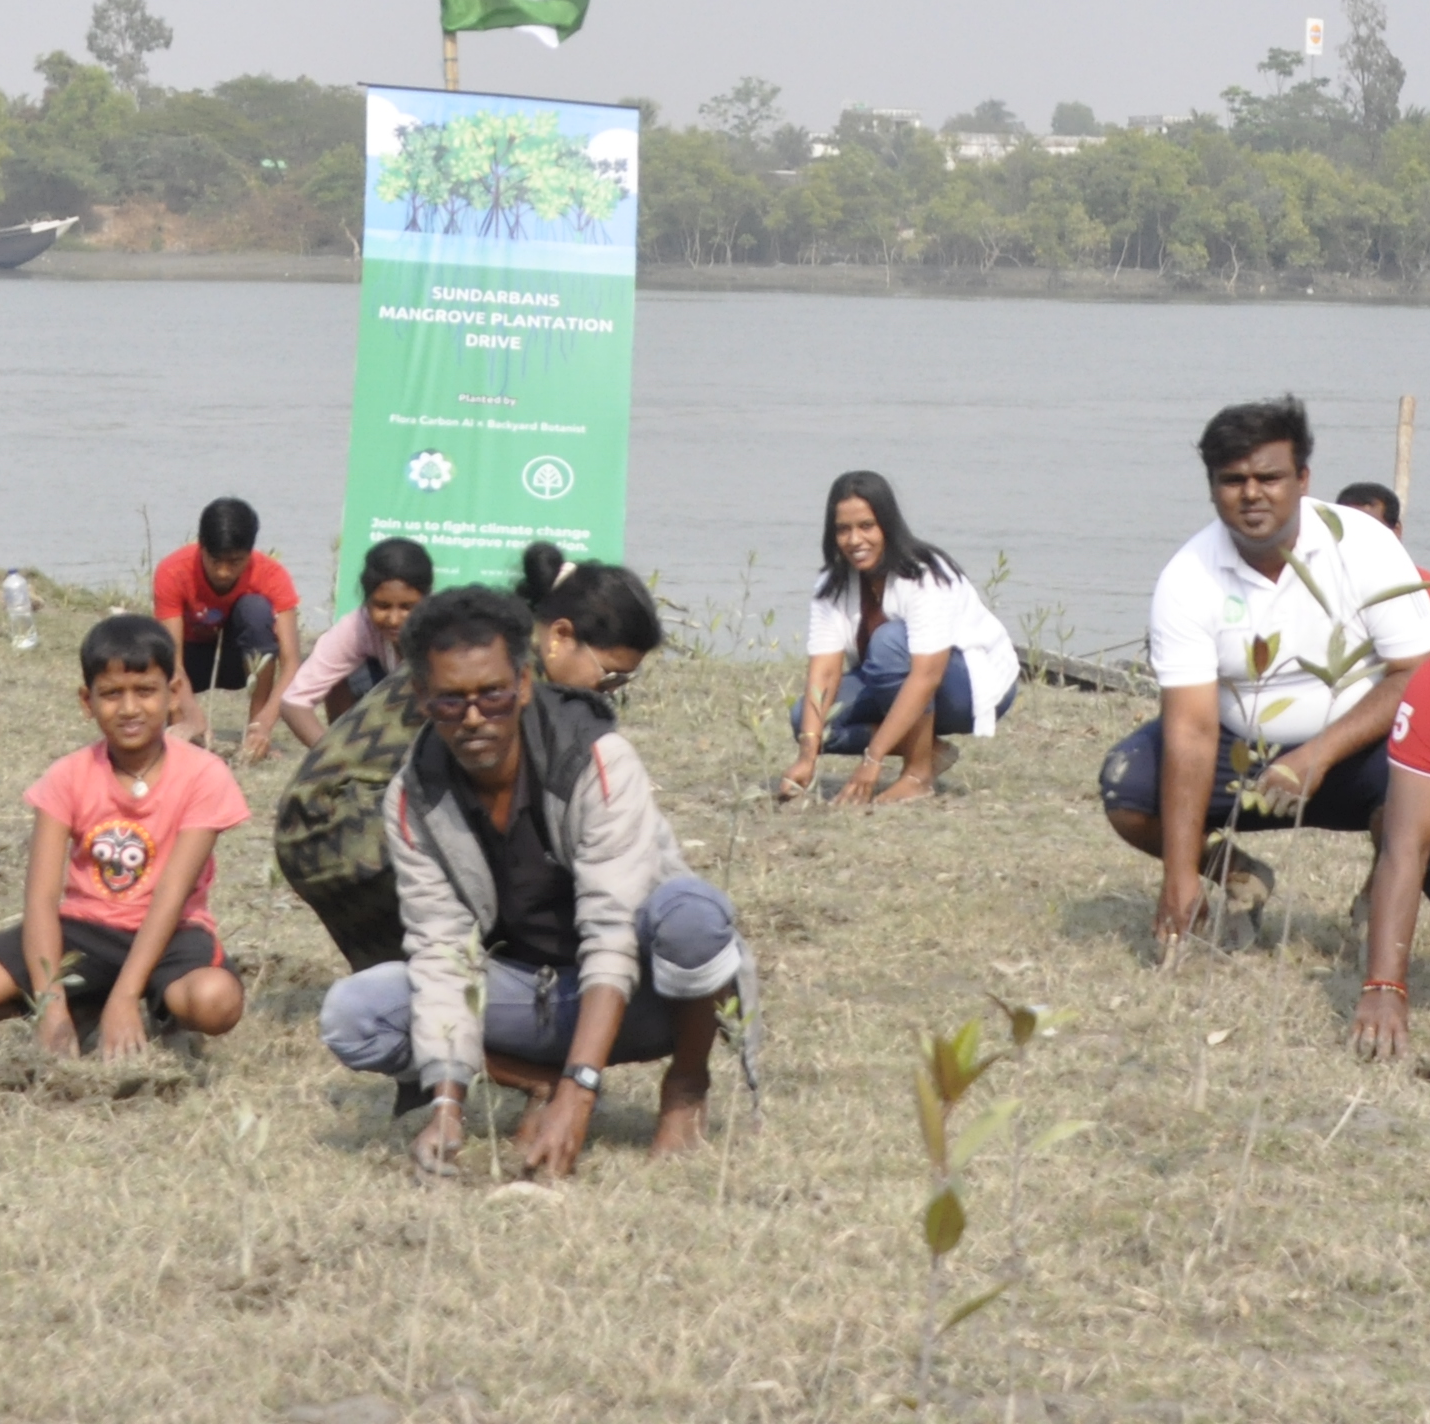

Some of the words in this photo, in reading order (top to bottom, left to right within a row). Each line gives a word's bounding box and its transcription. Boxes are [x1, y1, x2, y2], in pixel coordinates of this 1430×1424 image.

[432, 285, 560, 307] SUNDARBANS
[378, 305, 486, 325] MANGROVE
[490, 312, 613, 333] PLANTATION
[465, 333, 521, 350] DRIVE
[458, 393, 501, 405] Planted
[503, 397, 516, 407] by
[419, 415, 459, 427] Carbon
[487, 419, 538, 432] Backyard
[540, 422, 586, 433] Botanist
[371, 517, 402, 529] Join
[404, 521, 422, 531] us
[424, 521, 440, 531] to
[442, 520, 475, 534] fight
[479, 523, 534, 535] climate
[536, 525, 591, 540] change
[431, 534, 503, 548] Mangrove
[1391, 701, 1415, 743] 5
